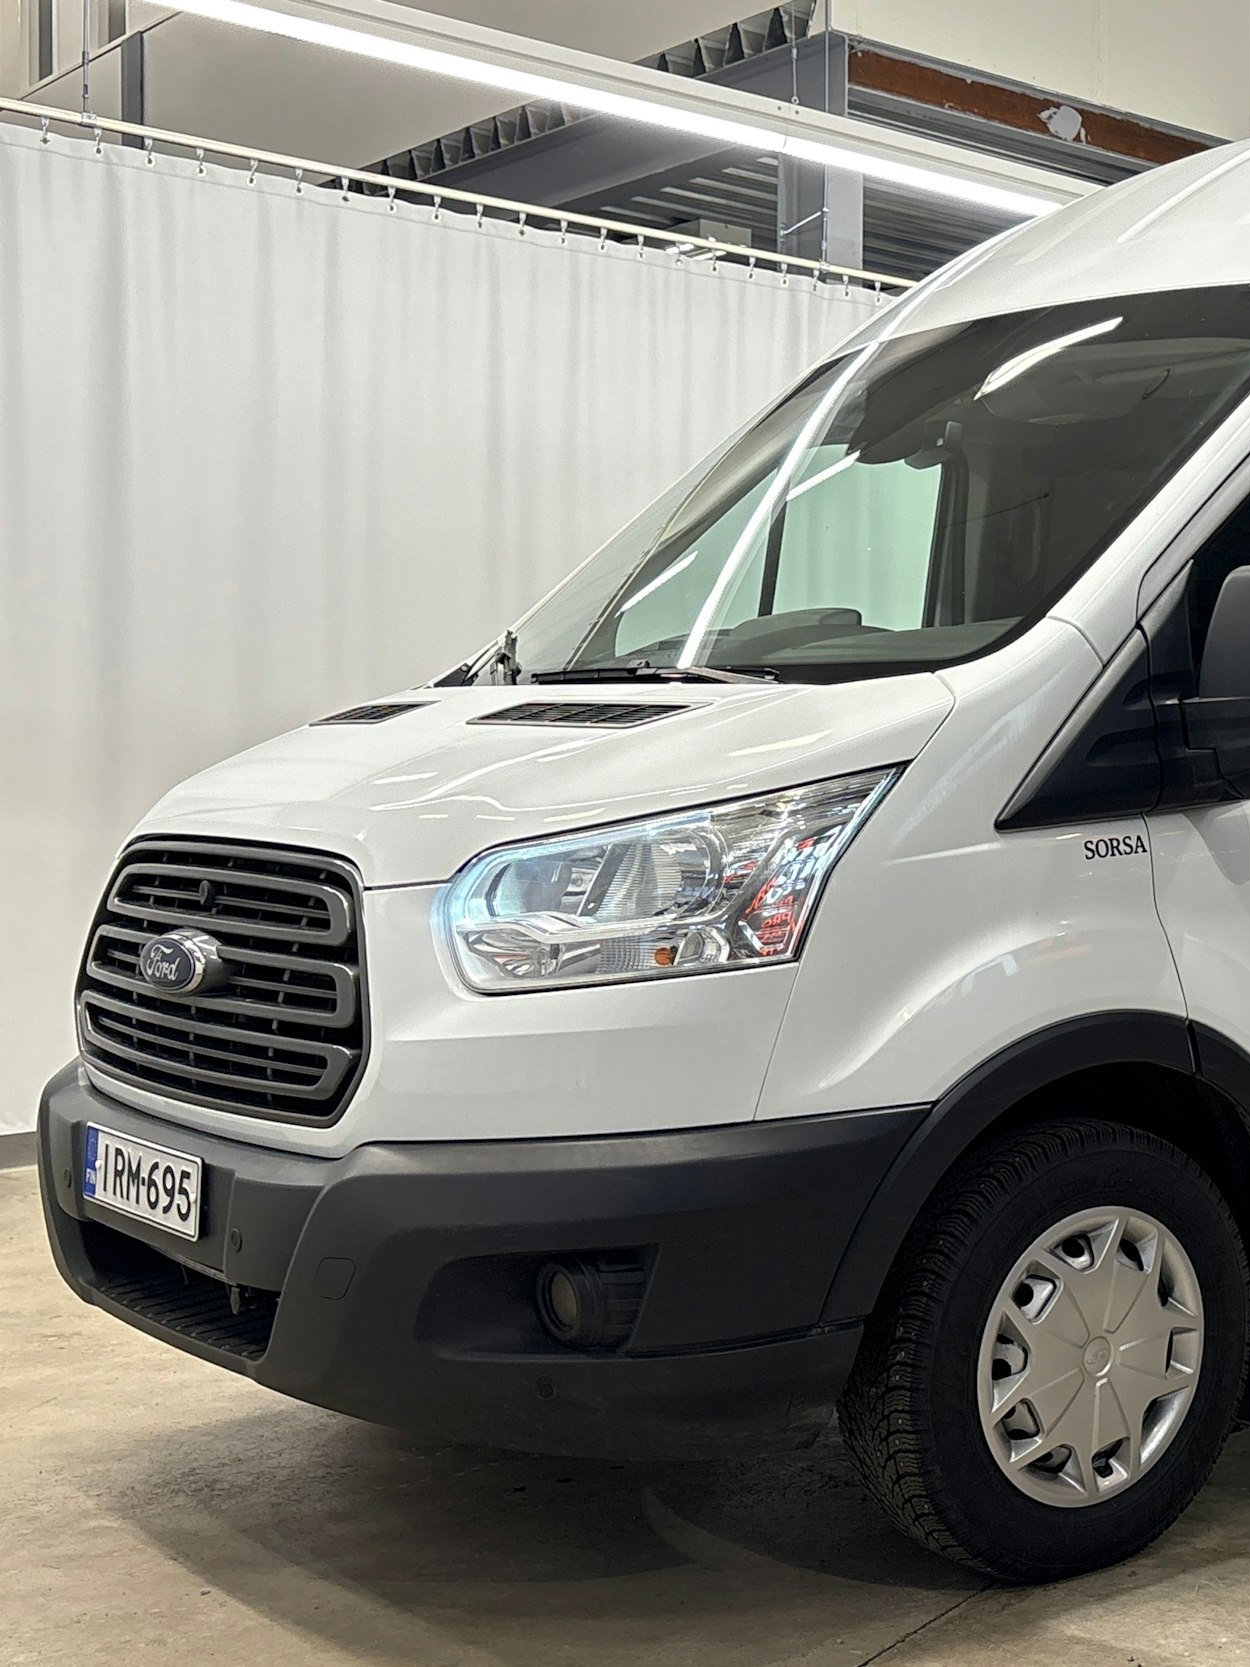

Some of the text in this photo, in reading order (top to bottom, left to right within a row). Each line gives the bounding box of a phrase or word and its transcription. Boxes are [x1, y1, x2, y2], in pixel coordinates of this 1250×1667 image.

[1083, 834, 1148, 860] SORSA
[145, 943, 181, 981] Ford
[102, 1143, 192, 1222] IRM-695
